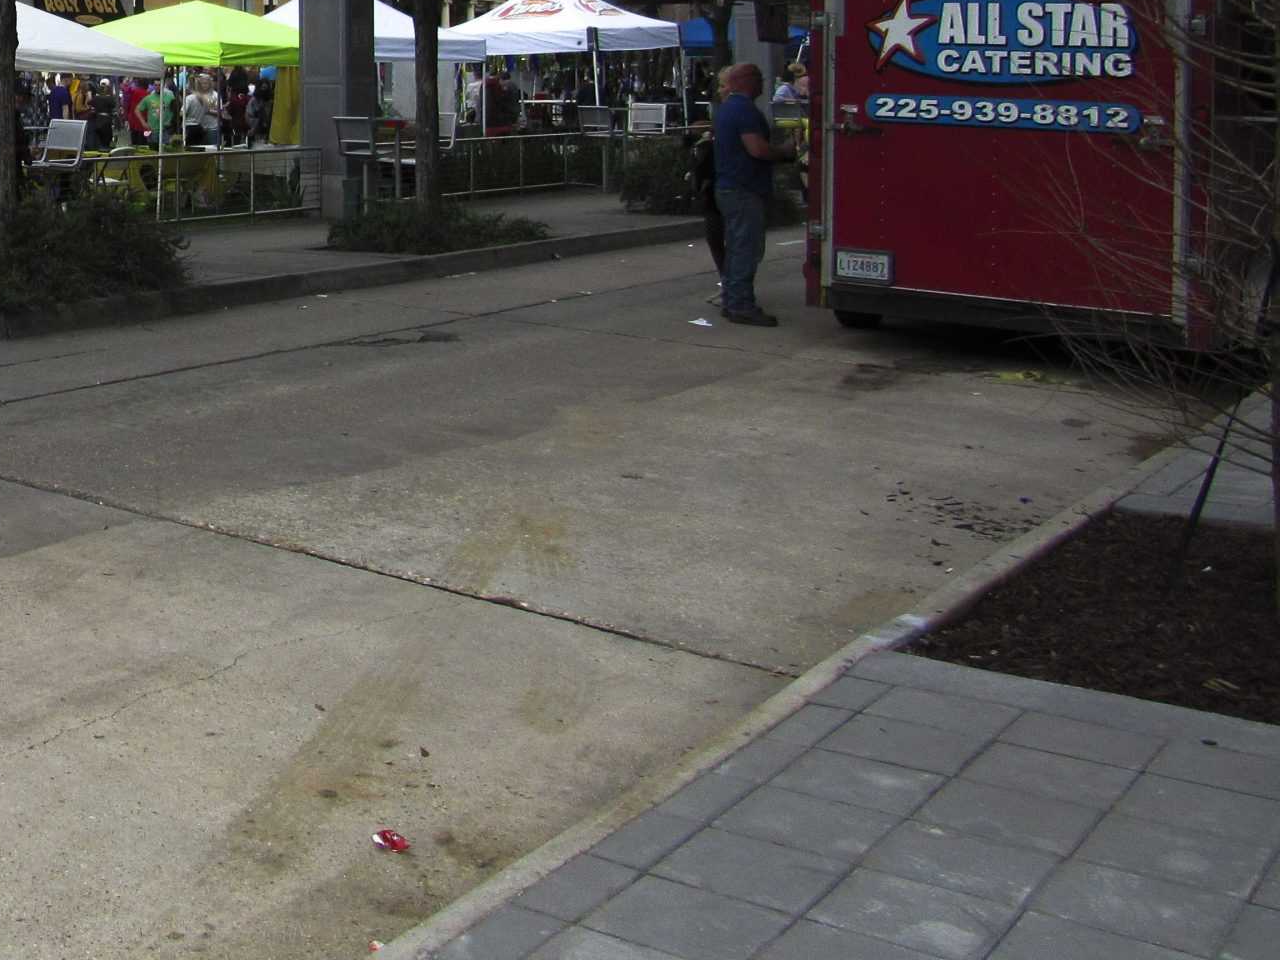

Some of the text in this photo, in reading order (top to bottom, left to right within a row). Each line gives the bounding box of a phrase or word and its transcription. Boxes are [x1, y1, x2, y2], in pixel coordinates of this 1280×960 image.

[936, 1, 1131, 47] ALL STAR
[936, 49, 1133, 78] CATERING
[873, 97, 1130, 129] 225-939-8812
